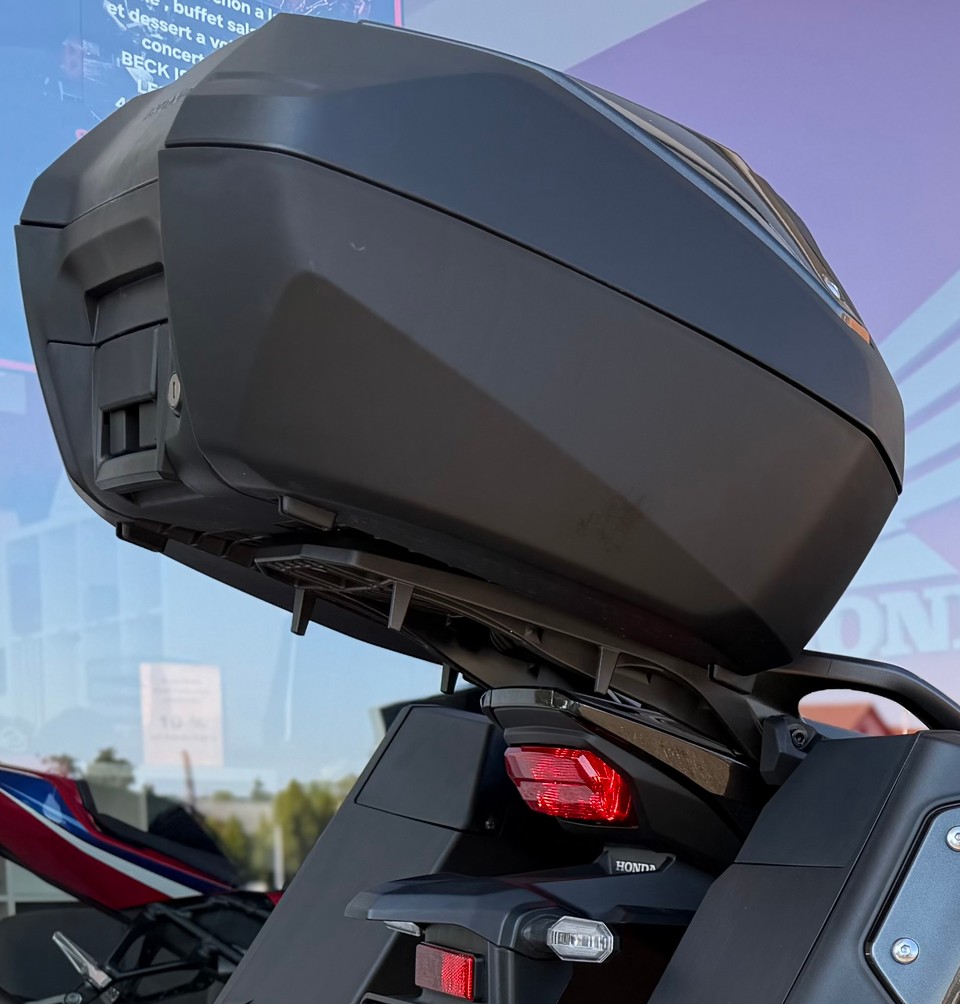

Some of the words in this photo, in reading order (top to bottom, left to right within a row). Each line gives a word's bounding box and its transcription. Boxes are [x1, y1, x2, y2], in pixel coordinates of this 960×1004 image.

[107, 3, 125, 18] et
[128, 8, 193, 40] dessert
[195, 32, 206, 45] a
[173, 0, 224, 28] buffet
[227, 20, 257, 35] sal
[254, 7, 264, 20] a
[121, 50, 170, 79] BECK
[615, 860, 657, 873] HONDA
